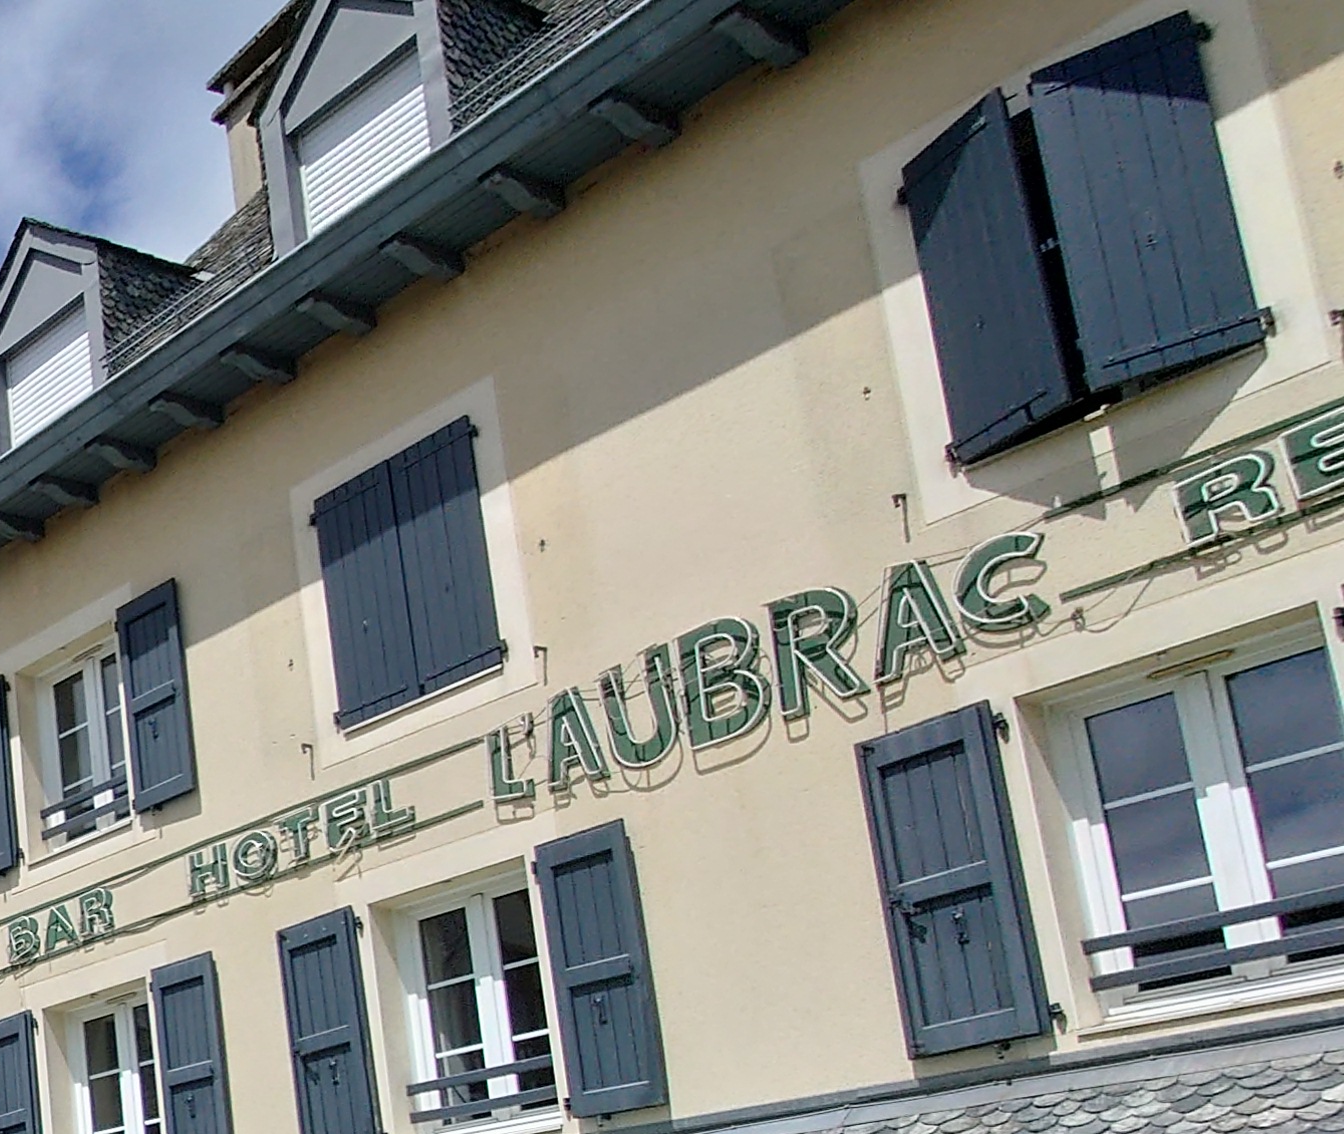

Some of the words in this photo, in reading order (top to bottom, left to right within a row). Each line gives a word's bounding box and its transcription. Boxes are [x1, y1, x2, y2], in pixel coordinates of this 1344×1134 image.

[485, 530, 1050, 802] L'AUBRAC
[7, 886, 114, 966] BAR
[185, 778, 415, 900] HOTEL
